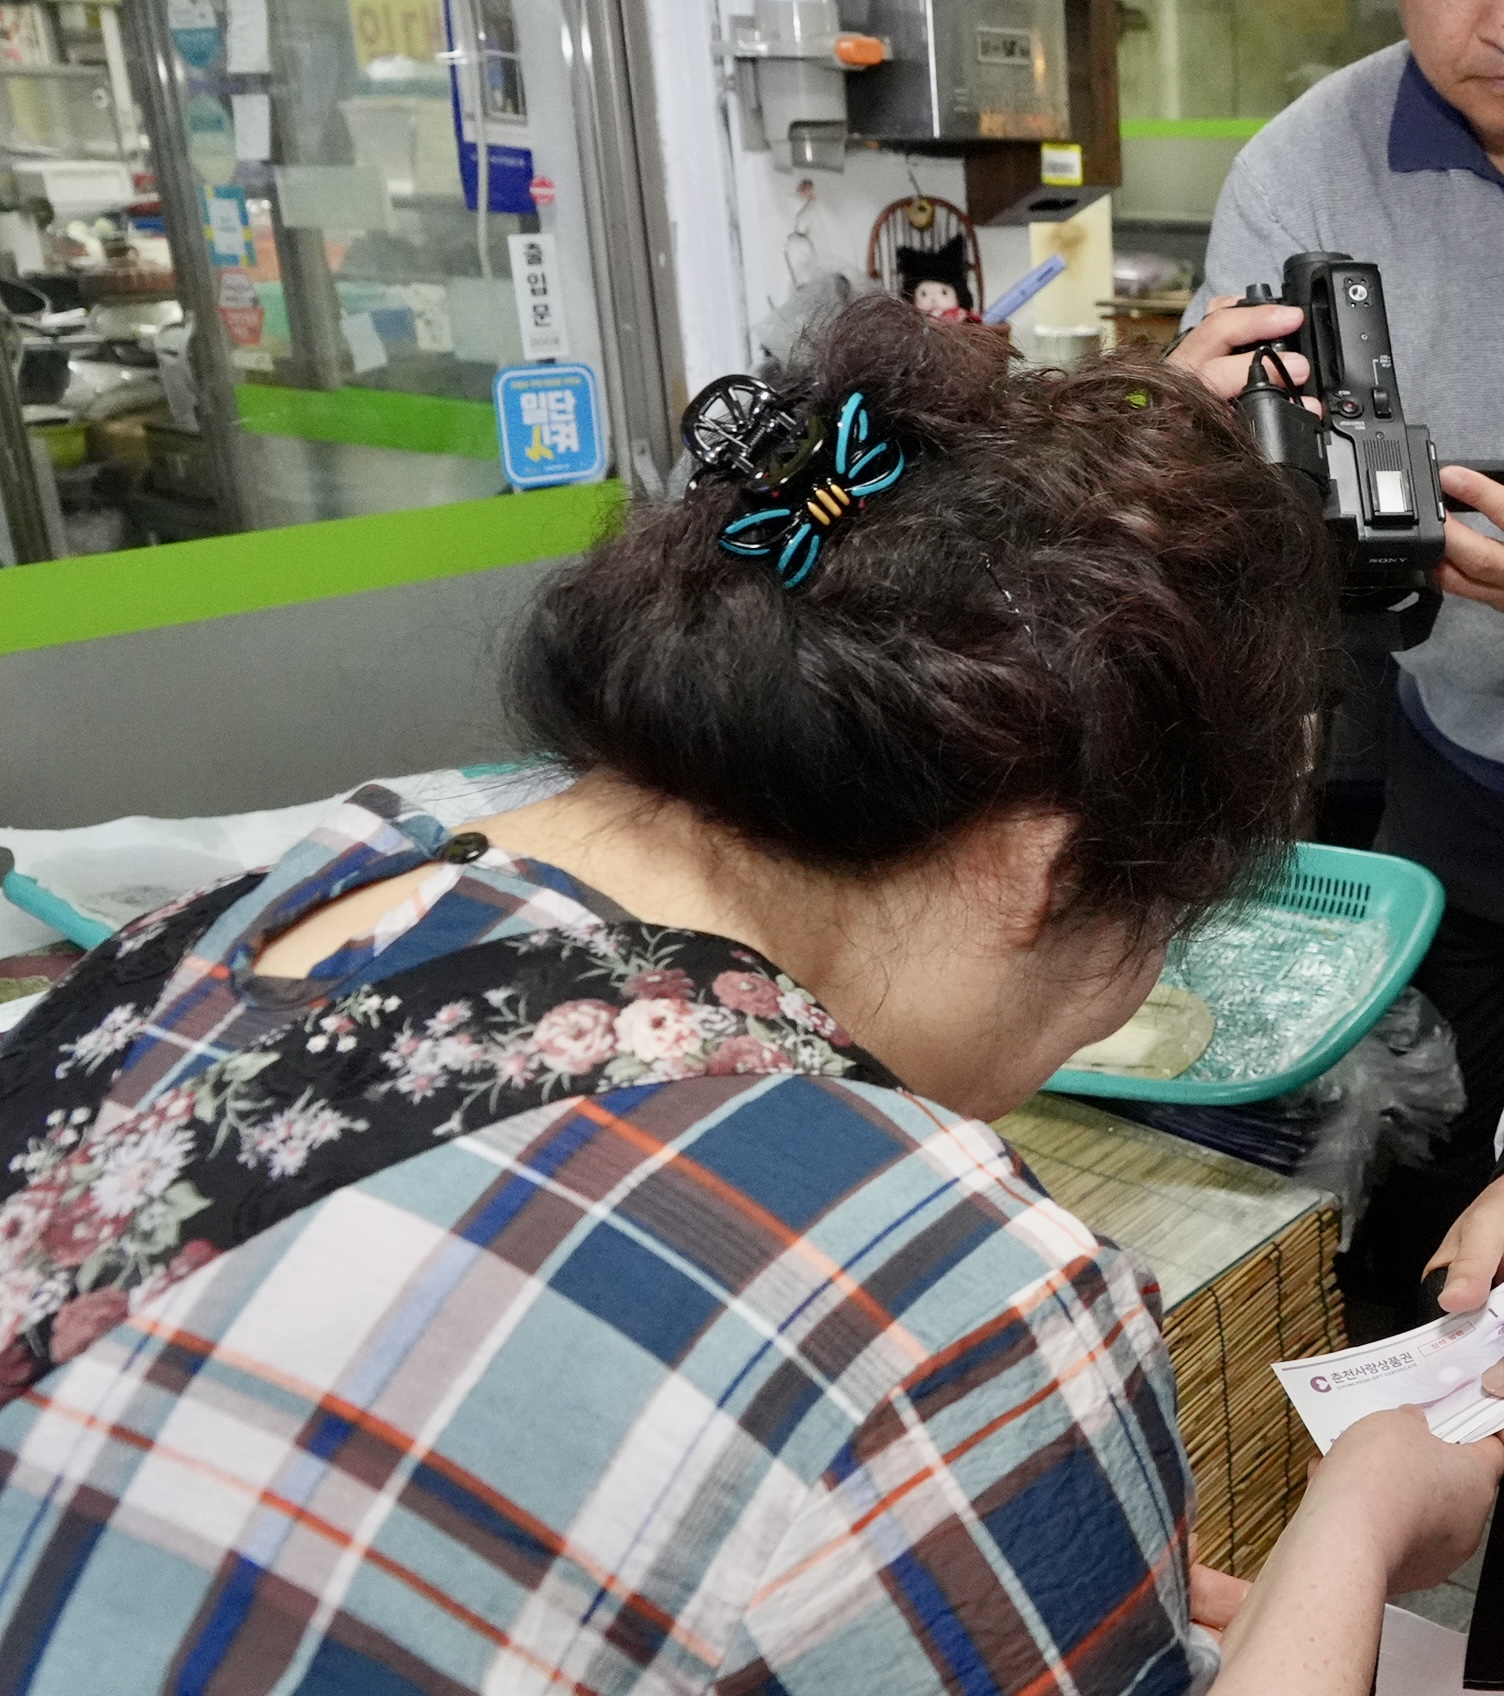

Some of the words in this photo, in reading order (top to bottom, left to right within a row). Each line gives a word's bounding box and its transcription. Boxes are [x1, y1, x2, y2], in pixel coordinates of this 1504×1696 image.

[1330, 1351, 1415, 1384] 춘천사랑상품권
[1336, 1378, 1371, 1391] CHUNCHEON
[1371, 1373, 1384, 1381] GIFT
[1384, 1362, 1418, 1377] CERTIFICATE
